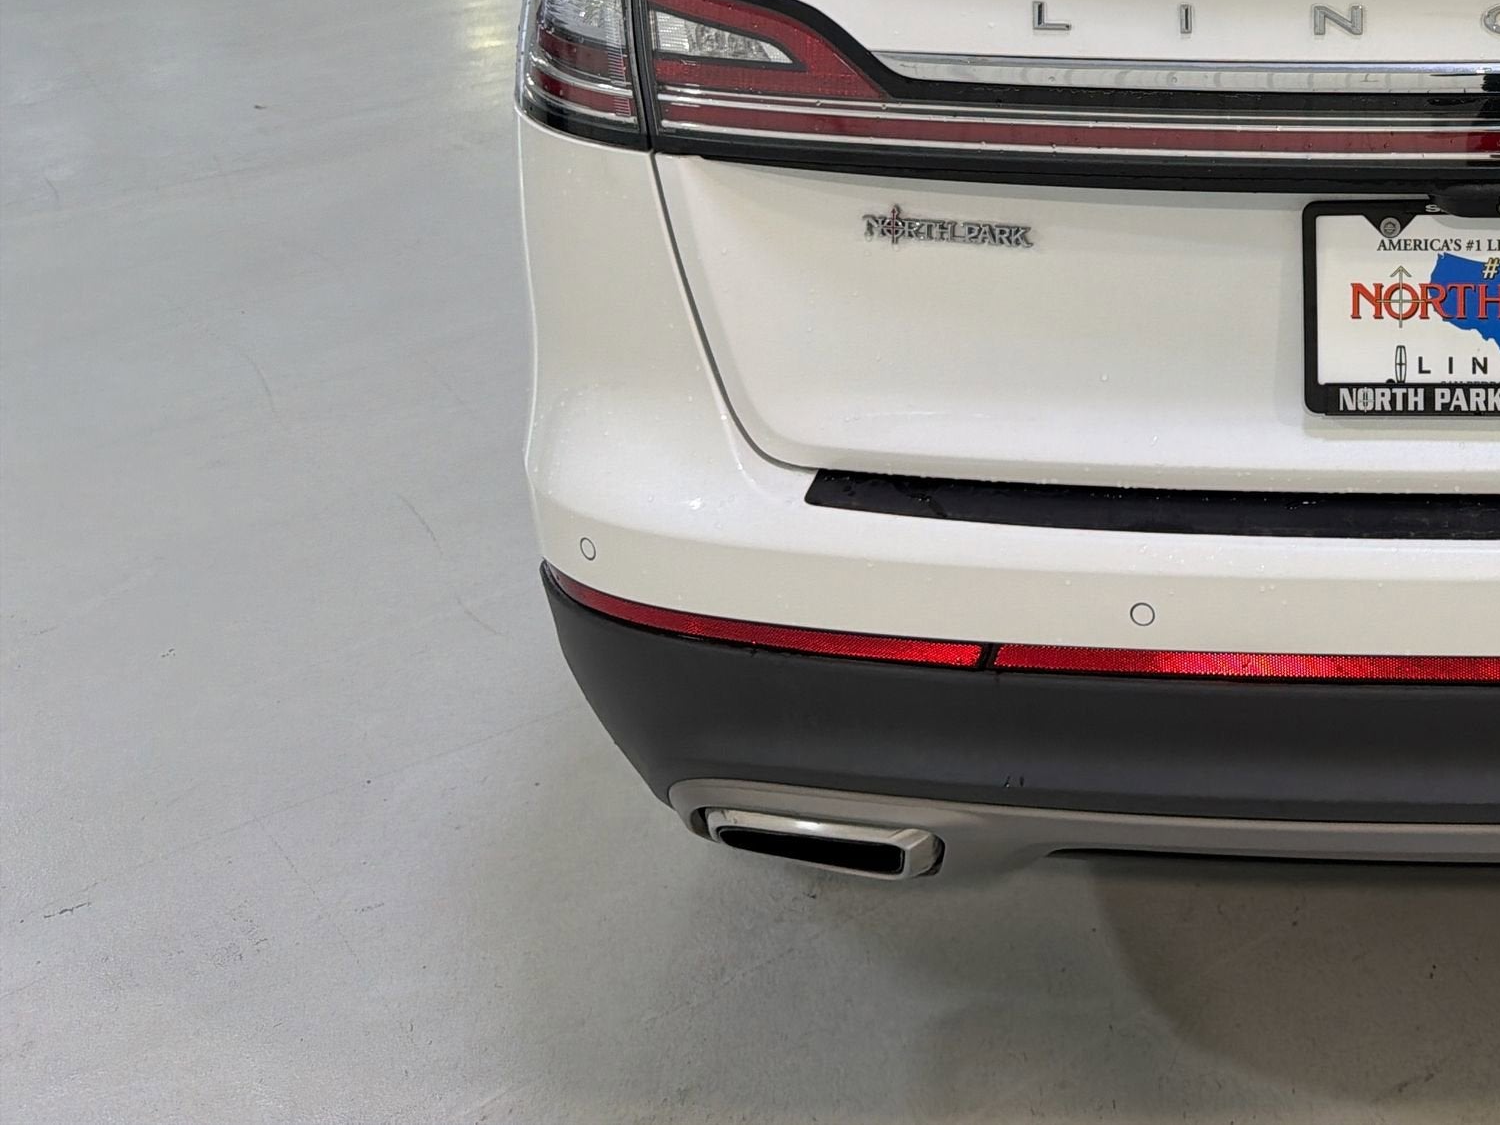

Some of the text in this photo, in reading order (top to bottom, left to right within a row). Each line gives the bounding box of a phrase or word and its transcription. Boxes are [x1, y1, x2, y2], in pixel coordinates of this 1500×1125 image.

[863, 214, 1035, 248] NORTH PARK
[1377, 238, 1463, 253] AMERICA'S
[1466, 239, 1483, 253] #1
[1339, 387, 1425, 412] NORTH
